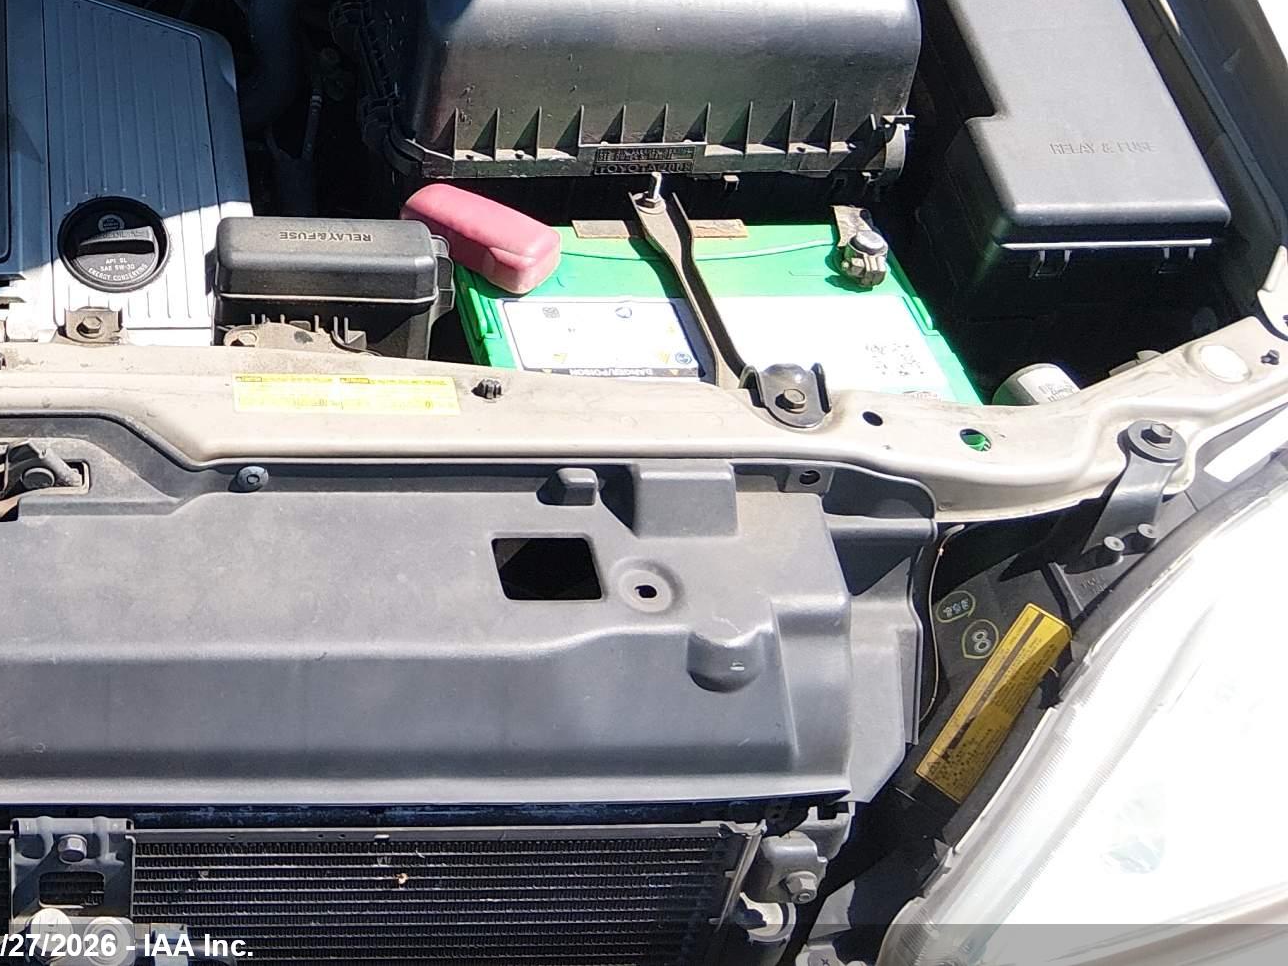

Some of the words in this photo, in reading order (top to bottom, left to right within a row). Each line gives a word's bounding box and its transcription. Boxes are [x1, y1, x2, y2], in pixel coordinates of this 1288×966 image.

[1049, 143, 1095, 155] RELAY
[1102, 143, 1115, 154] &
[1118, 141, 1157, 154] FUSE
[278, 231, 372, 243] RELAY&FUSE
[87, 267, 111, 281] ENERGY
[113, 263, 149, 281] CONSERVING
